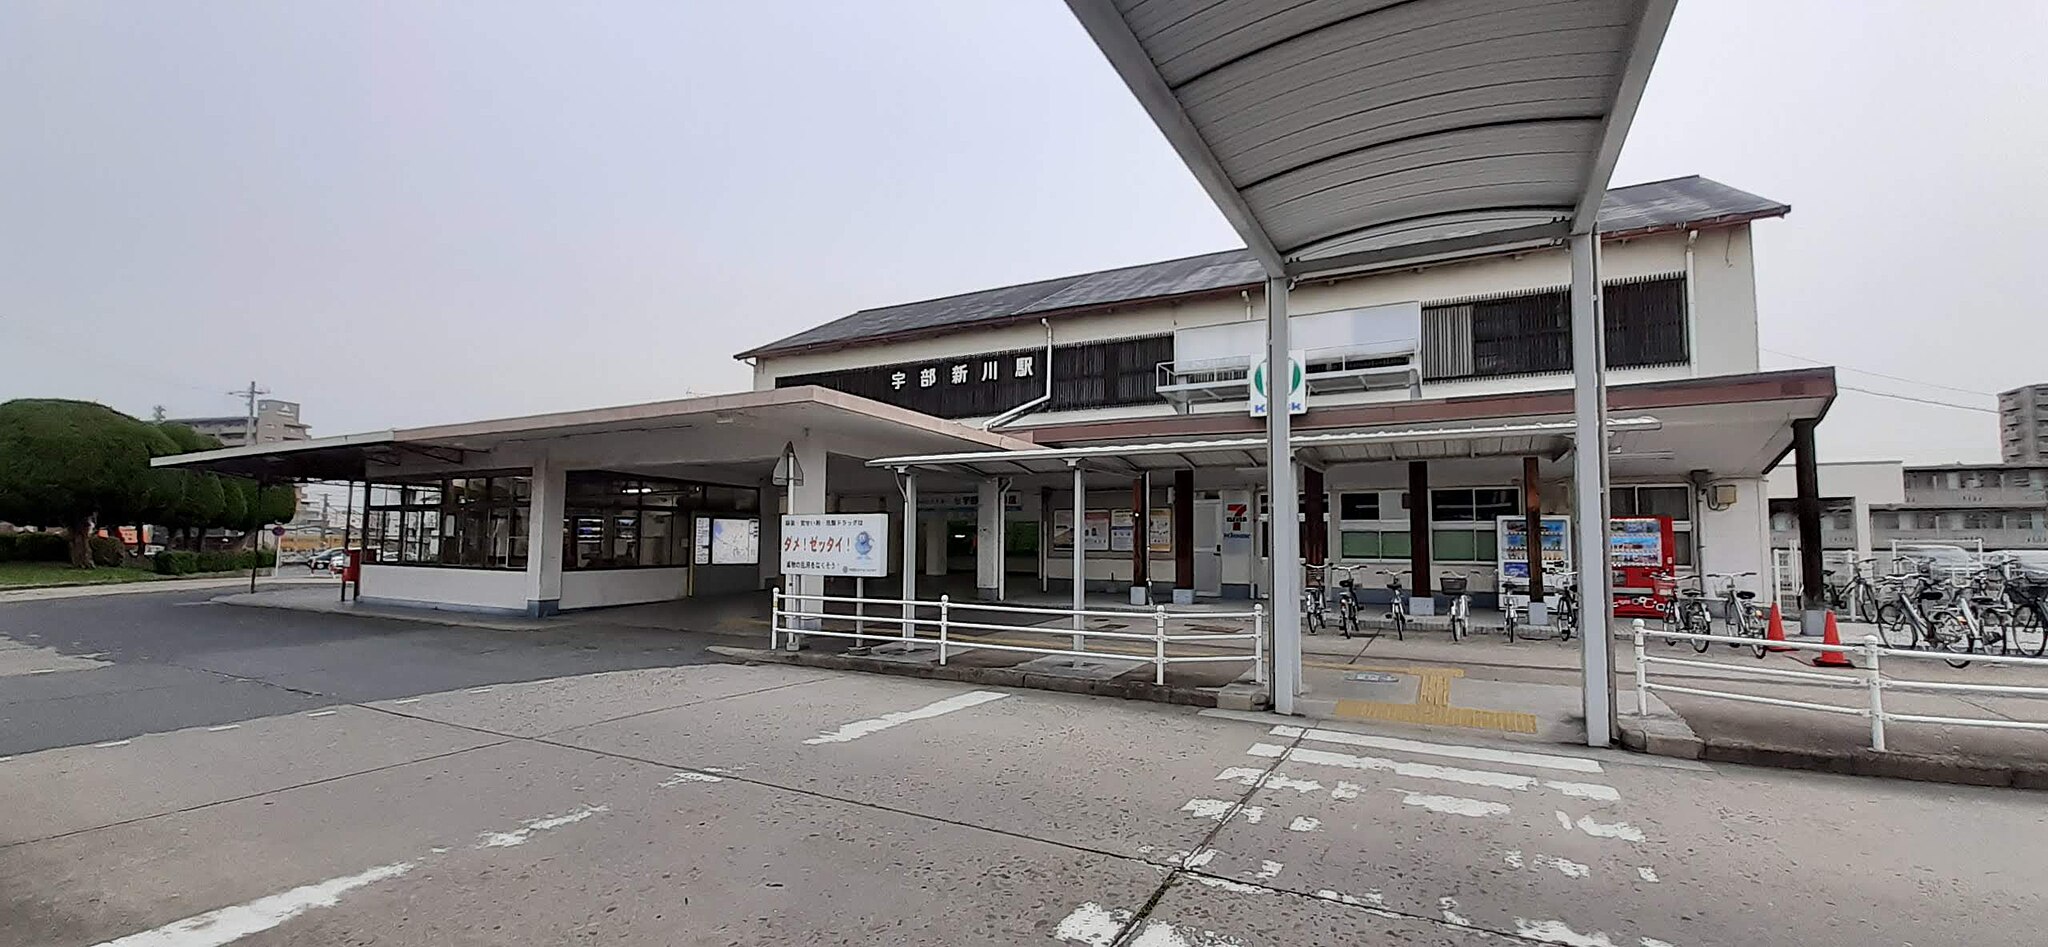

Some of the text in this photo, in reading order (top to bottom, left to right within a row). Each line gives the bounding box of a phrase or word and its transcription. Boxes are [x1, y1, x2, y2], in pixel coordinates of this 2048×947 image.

[891, 357, 1034, 390] 宇部新川駅
[784, 535, 851, 553] ダメ！ゼッタイ！
